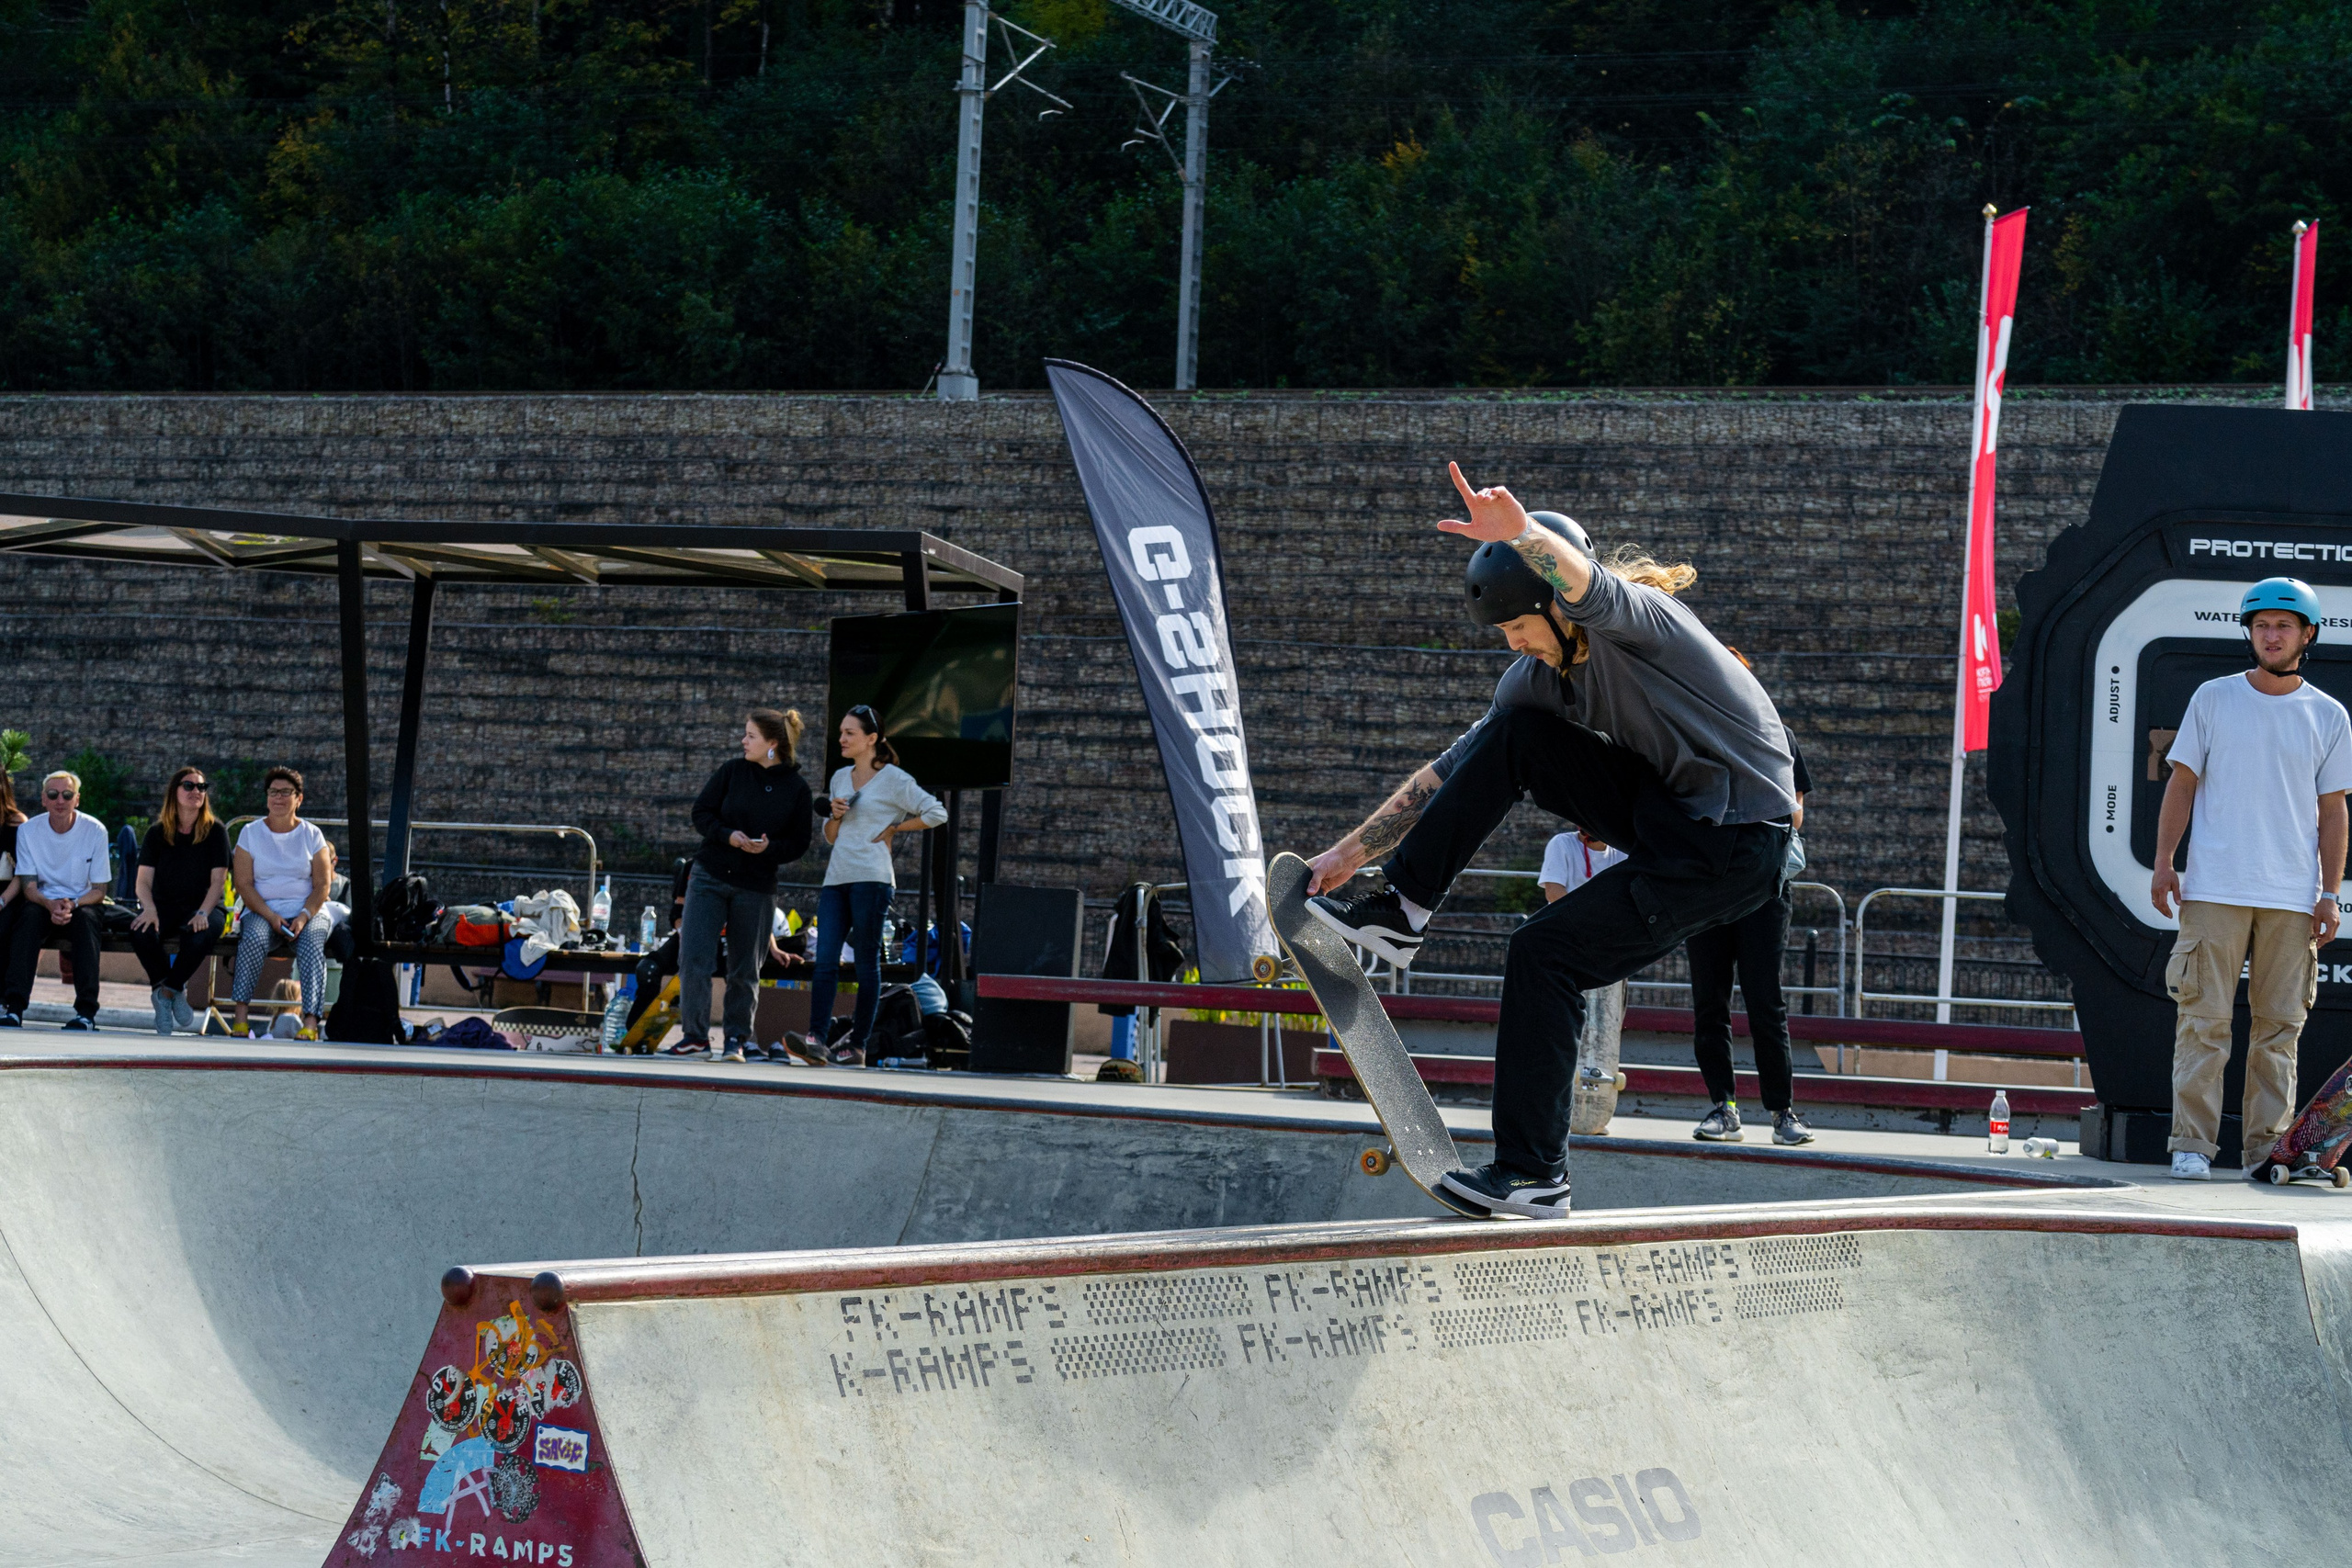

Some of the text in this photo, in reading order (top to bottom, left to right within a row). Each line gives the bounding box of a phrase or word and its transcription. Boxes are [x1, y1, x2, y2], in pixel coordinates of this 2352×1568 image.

[2194, 611, 2241, 623] WATE
[2109, 678, 2120, 723] ADJUST
[2107, 784, 2117, 820] MODE
[1471, 1467, 1701, 1568] CASIO
[417, 1525, 573, 1567] FK-RAMPS
